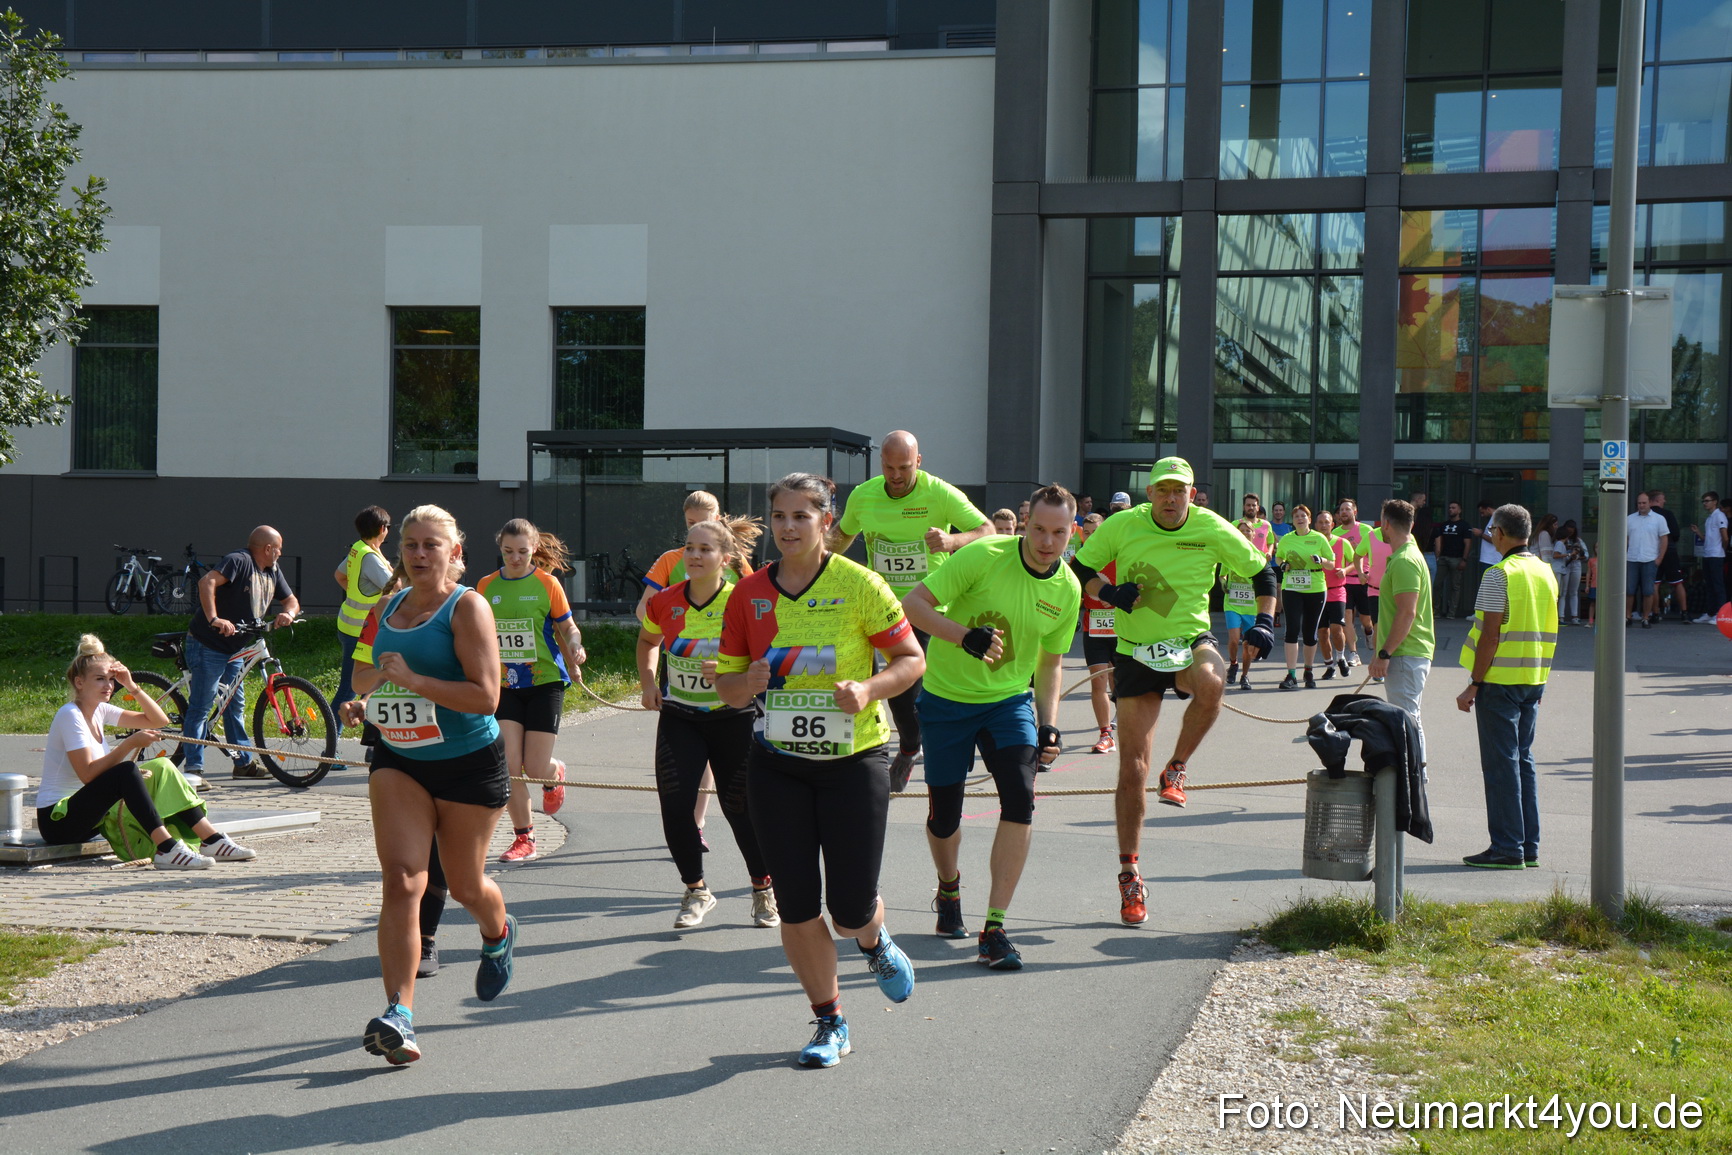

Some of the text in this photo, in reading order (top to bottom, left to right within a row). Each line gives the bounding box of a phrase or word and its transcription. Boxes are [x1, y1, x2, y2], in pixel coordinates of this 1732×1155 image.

[878, 542, 922, 555] BOCK
[884, 558, 916, 571] 152
[885, 574, 917, 582] STEFAN
[1291, 576, 1306, 584] 153
[1234, 591, 1250, 599] 155
[496, 620, 529, 631] OCK
[1096, 619, 1115, 628] 545
[669, 658, 702, 671] BOC
[377, 702, 418, 724] 513
[791, 715, 826, 738] 86
[385, 730, 420, 740] TANJA
[780, 740, 839, 756] JESSI
